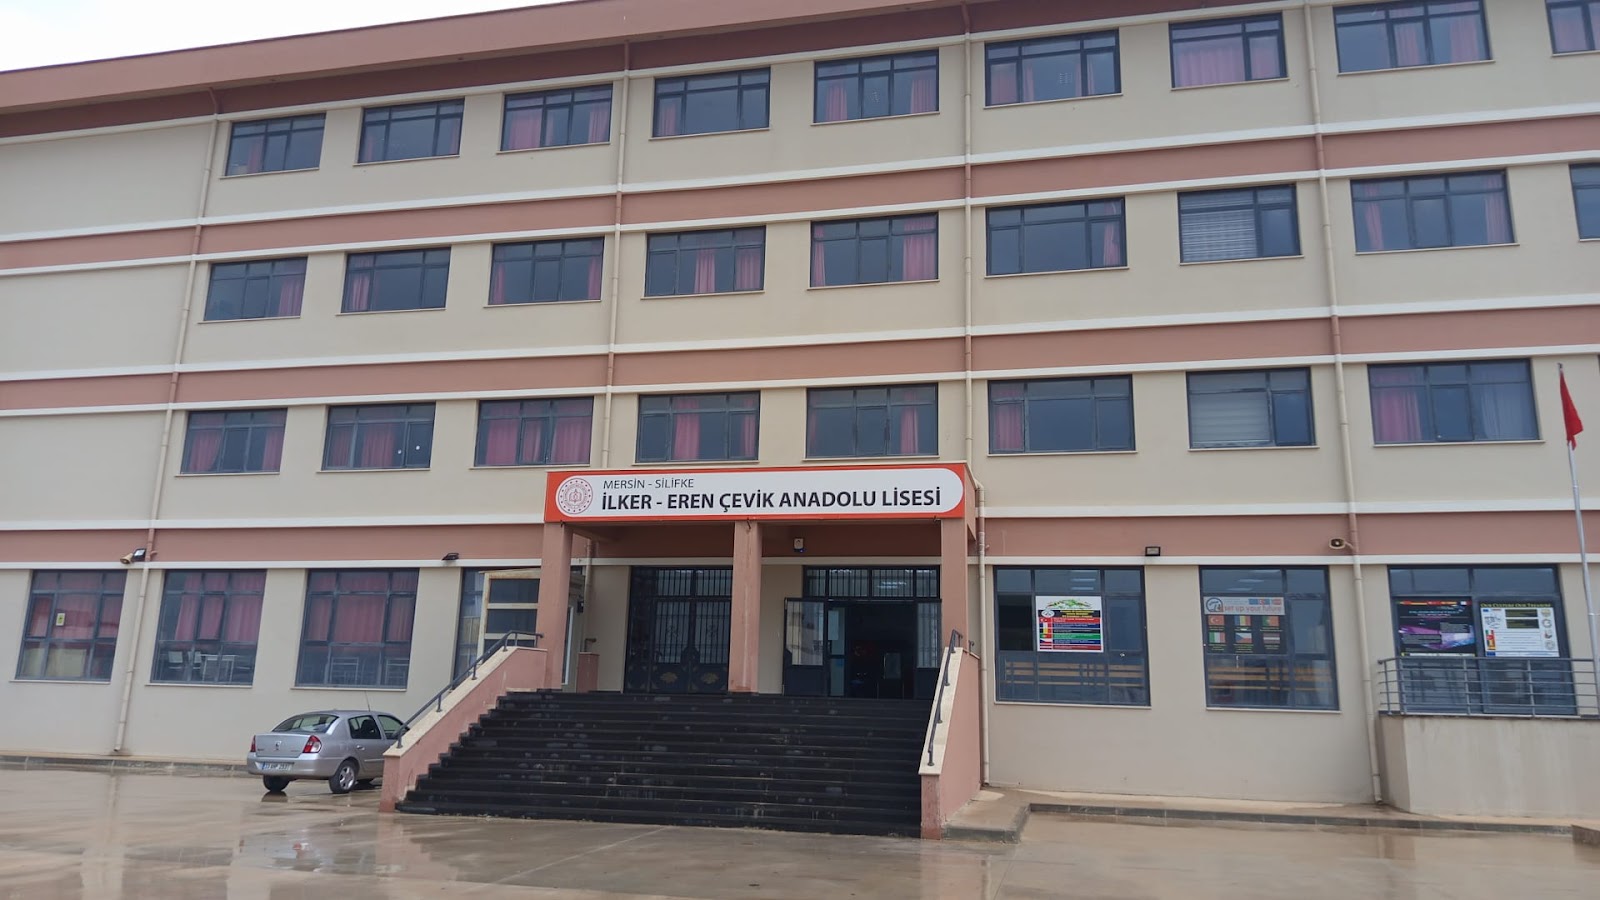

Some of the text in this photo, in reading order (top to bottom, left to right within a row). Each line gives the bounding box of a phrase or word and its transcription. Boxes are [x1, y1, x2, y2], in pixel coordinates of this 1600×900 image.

[603, 478, 645, 489] MERSİN
[655, 477, 694, 489] SİLİFKE
[602, 492, 652, 510] İLKER
[667, 493, 714, 509] EREN
[719, 489, 775, 513] ÇEVİK
[779, 491, 876, 507] ANADOLU
[882, 486, 941, 506] LİSESİ
